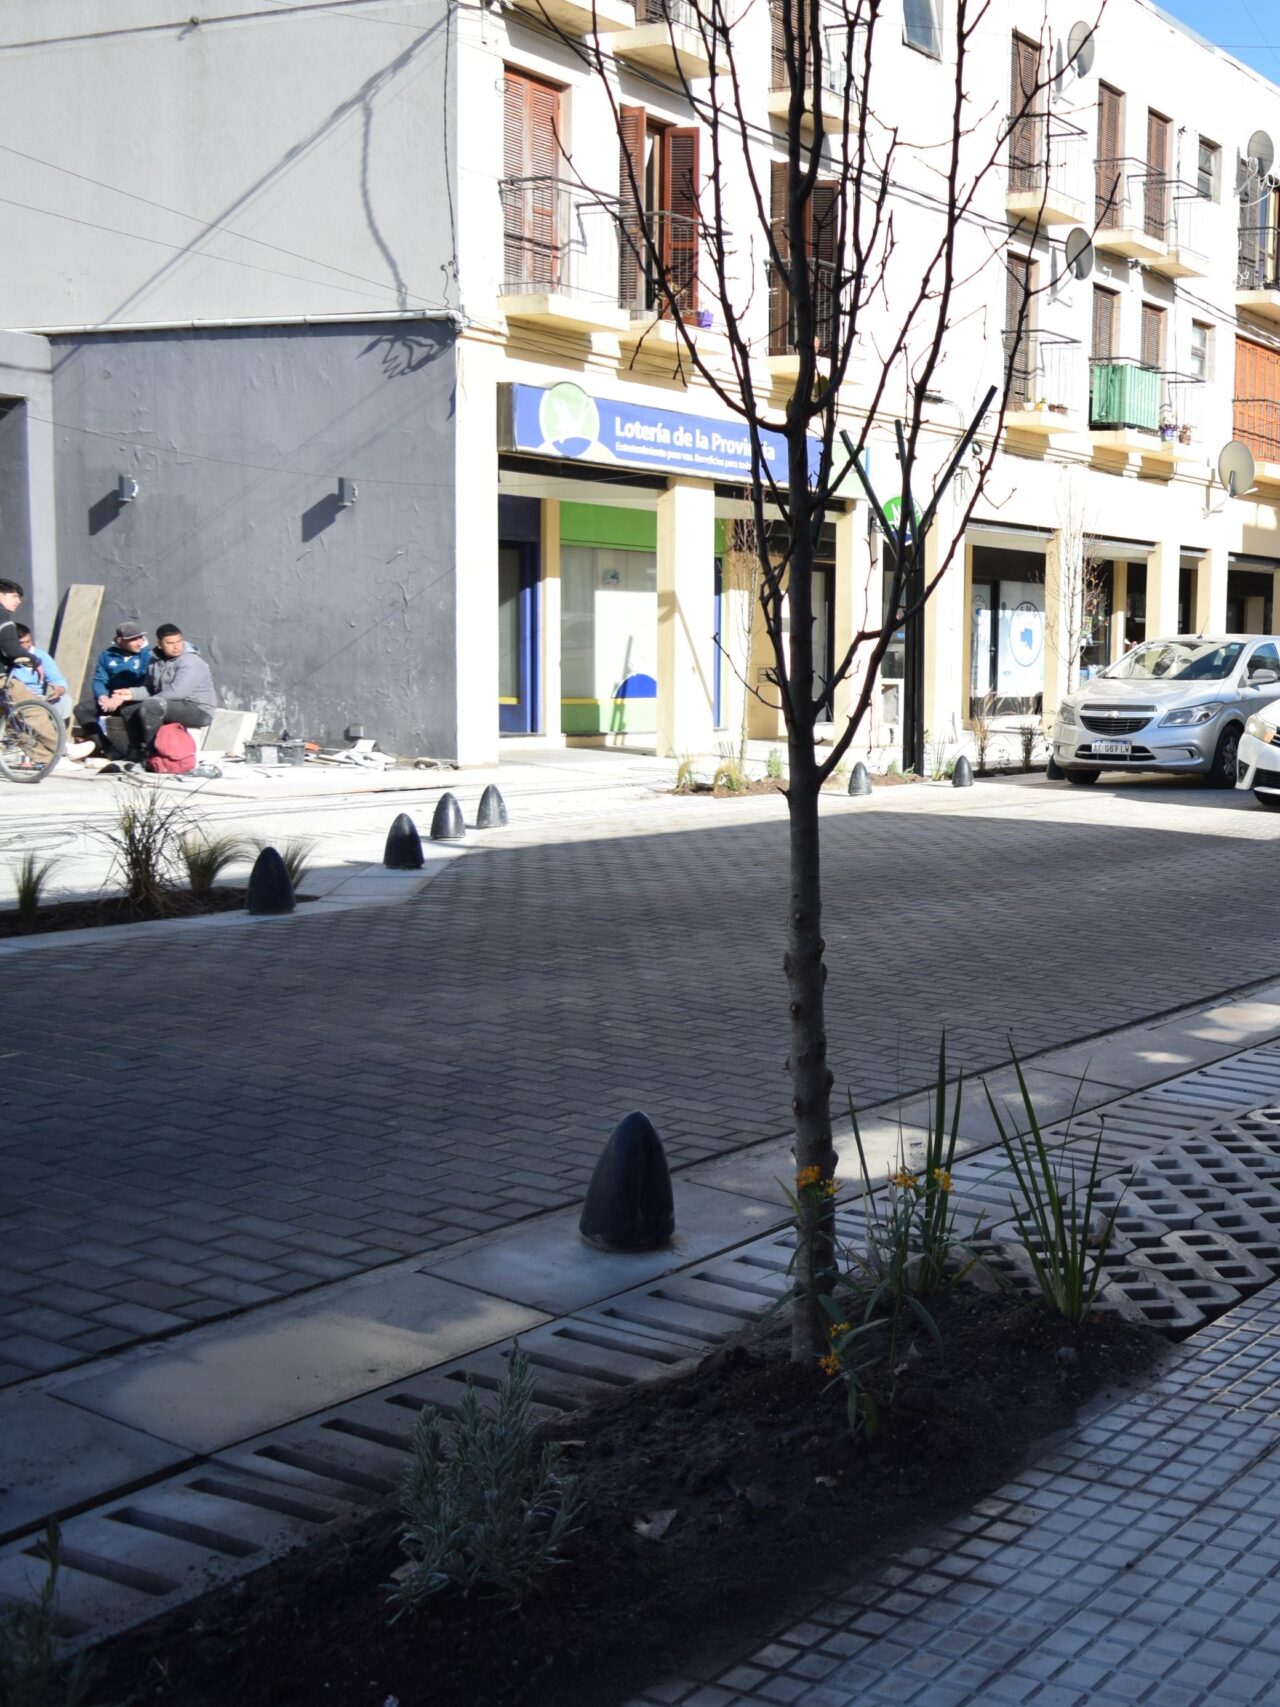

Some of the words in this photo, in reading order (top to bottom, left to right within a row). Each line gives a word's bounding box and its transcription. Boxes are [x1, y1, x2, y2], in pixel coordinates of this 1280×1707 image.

[616, 416, 671, 443] Lotería
[673, 426, 693, 448] de
[695, 429, 709, 450] la
[711, 431, 775, 461] Proviia
